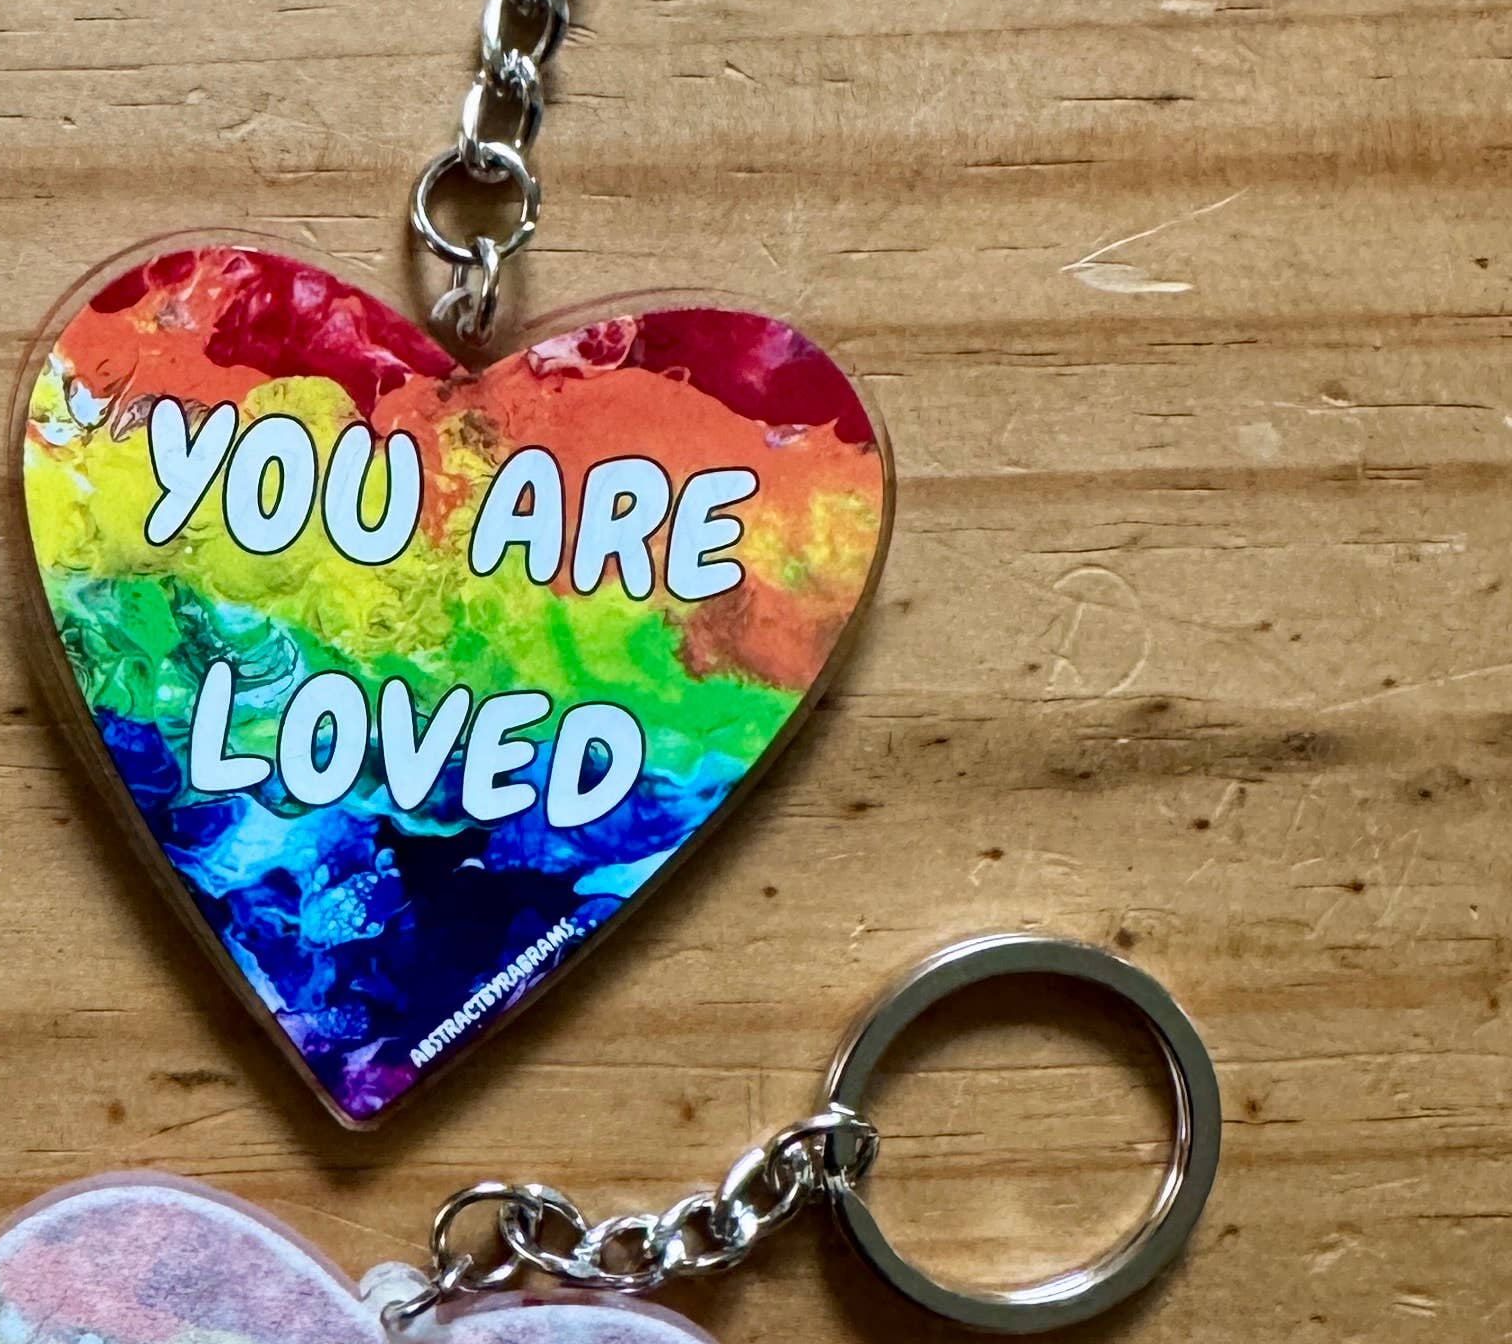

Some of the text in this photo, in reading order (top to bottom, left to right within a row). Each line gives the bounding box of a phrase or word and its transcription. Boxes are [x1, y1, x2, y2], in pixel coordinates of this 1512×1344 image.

[144, 396, 759, 603] YOU ARE
[185, 658, 647, 829] LOVED
[409, 917, 575, 1068] ABSTRACTBYRABRAMS
